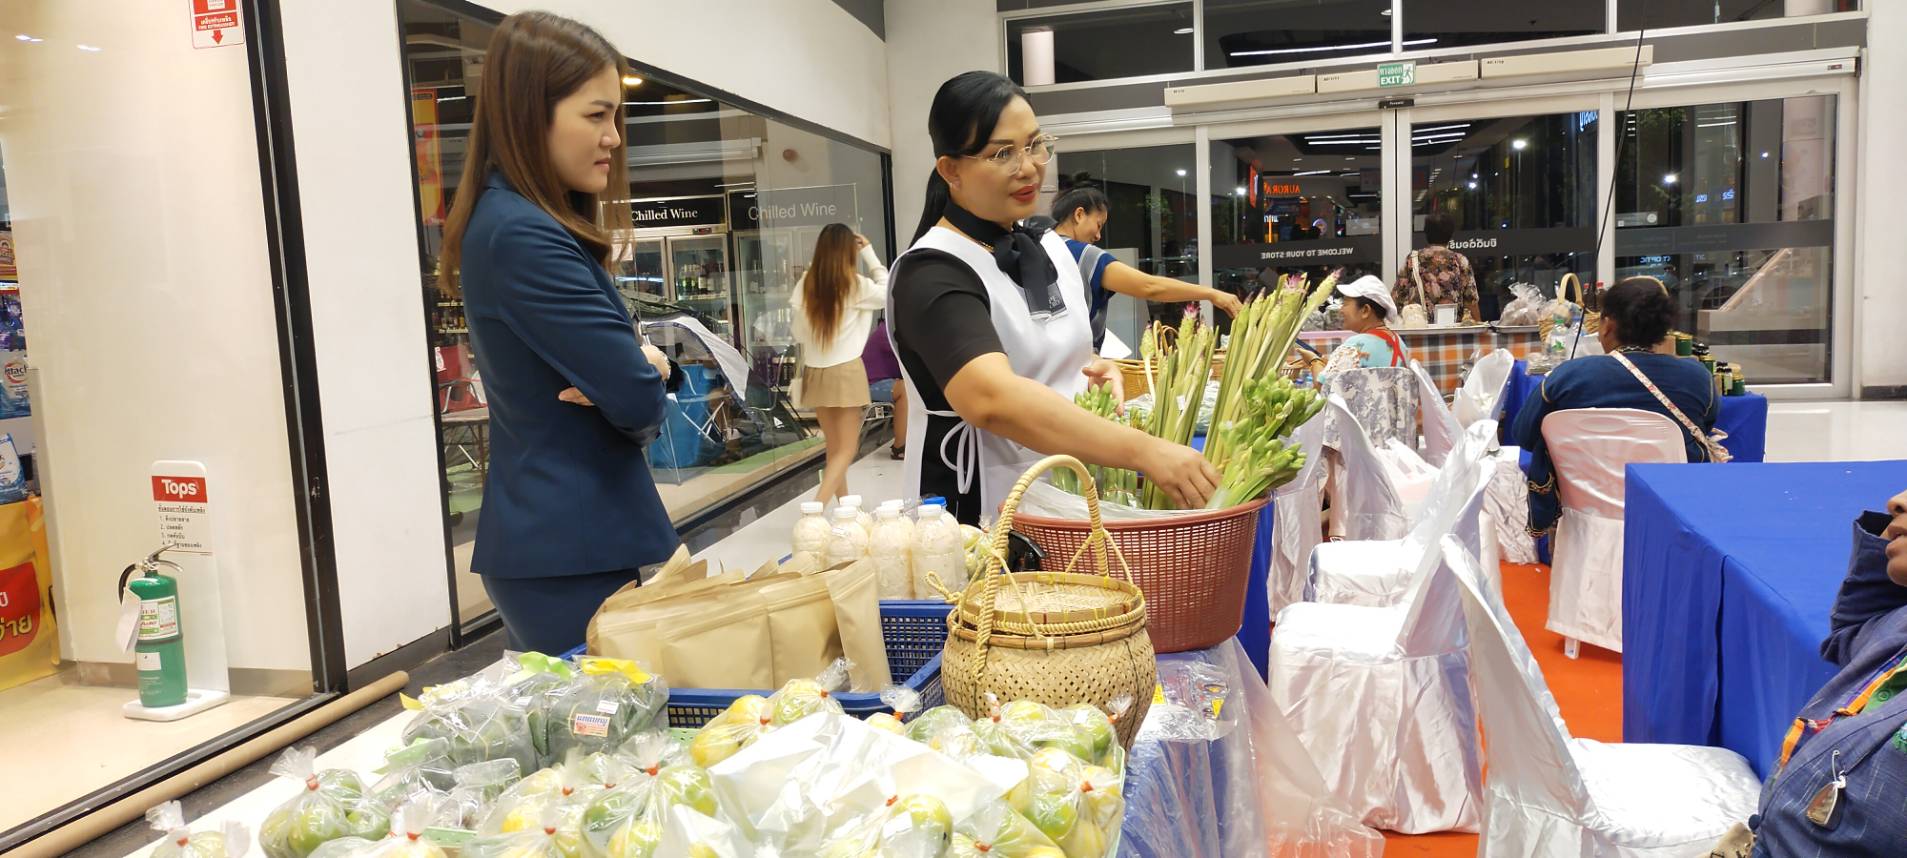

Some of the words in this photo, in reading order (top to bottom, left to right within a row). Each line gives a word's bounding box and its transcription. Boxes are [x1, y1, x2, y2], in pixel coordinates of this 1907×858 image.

[1381, 76, 1401, 85] EXIT
[631, 207, 669, 222] Chilled
[670, 206, 698, 220] Wine
[748, 204, 796, 221] Chilled
[799, 203, 837, 217] Wine
[161, 479, 197, 499] Tops
